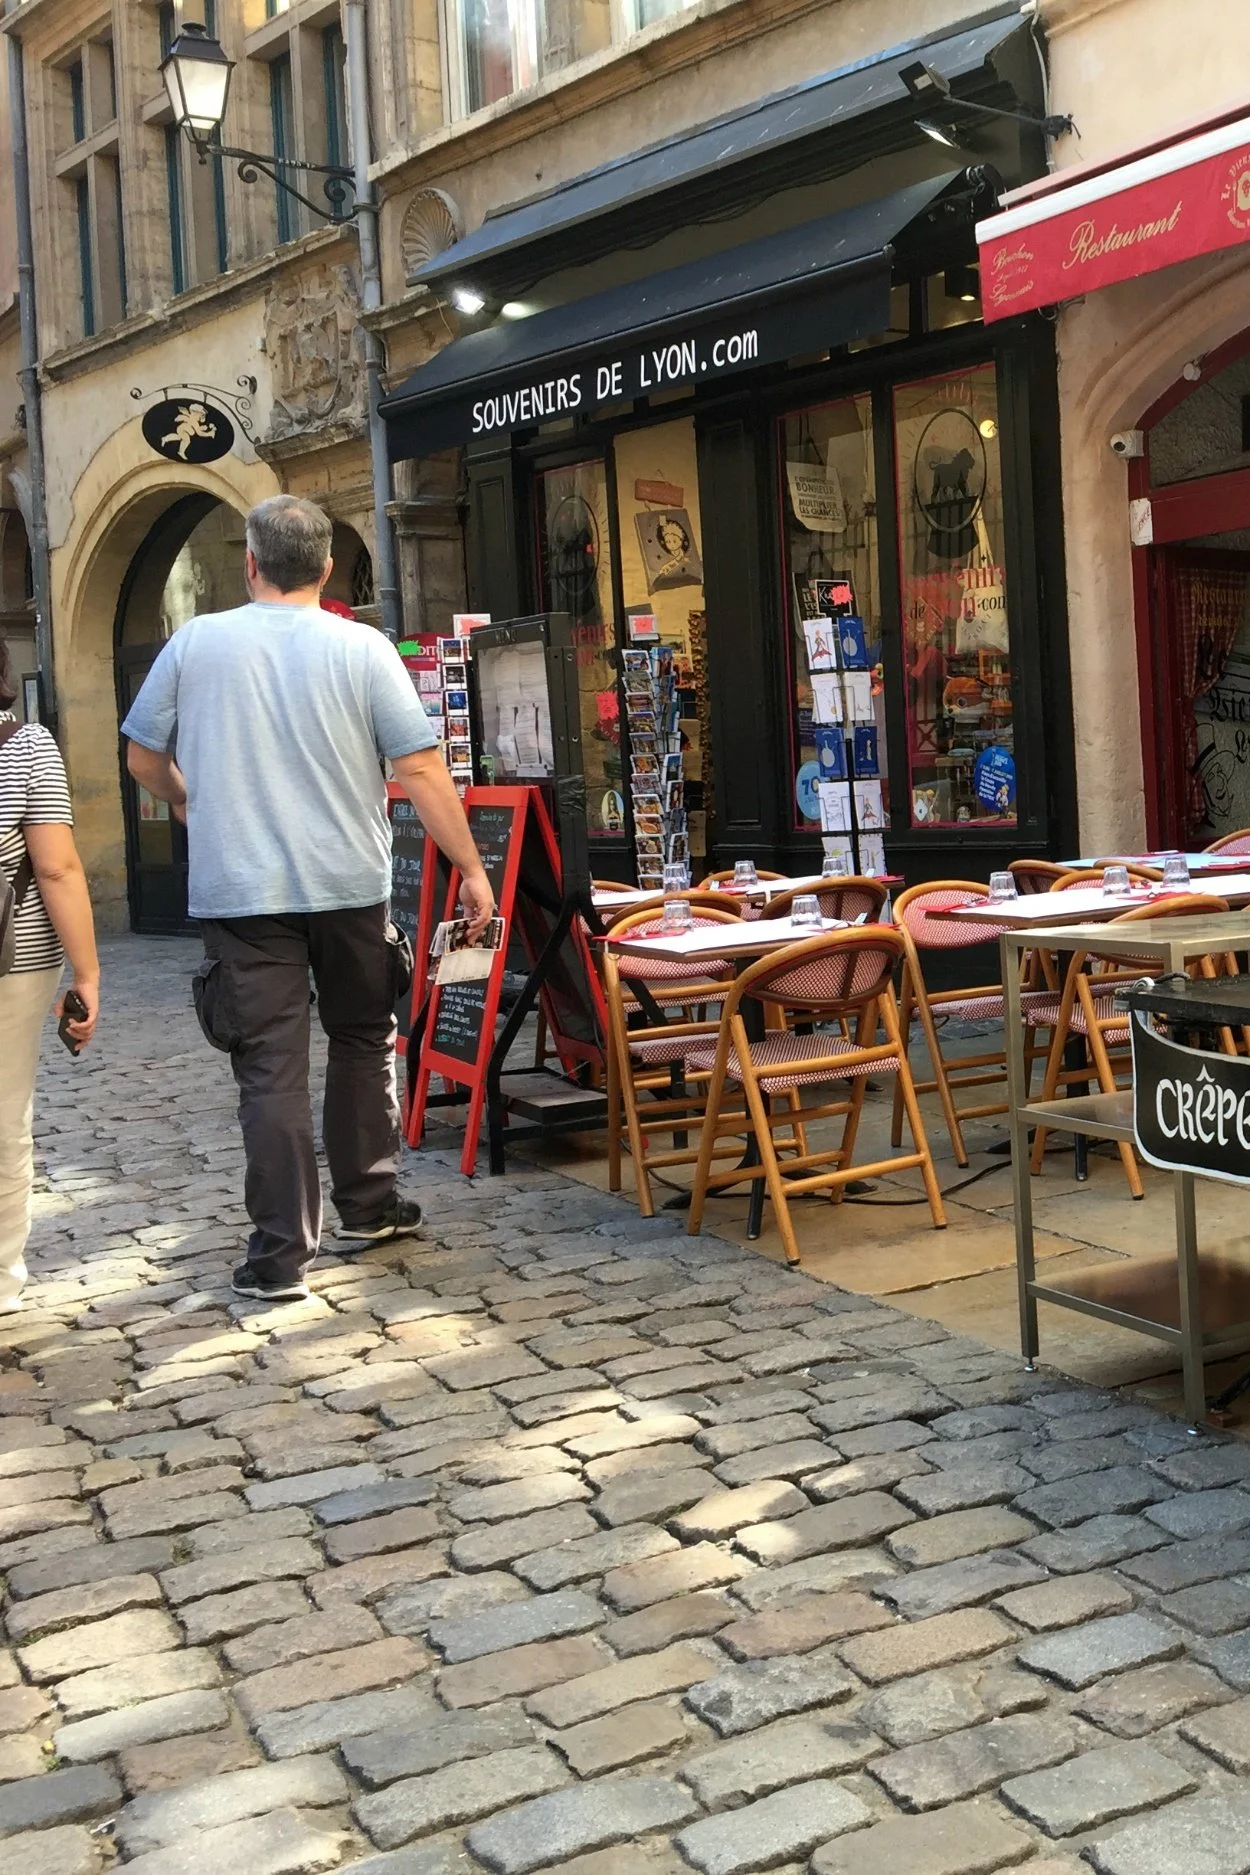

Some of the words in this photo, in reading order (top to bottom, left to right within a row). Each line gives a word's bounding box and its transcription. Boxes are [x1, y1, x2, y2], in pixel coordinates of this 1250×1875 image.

[1062, 200, 1182, 270] Restaurant
[471, 373, 582, 434] SOUVENIRS
[597, 361, 623, 400] DE
[640, 329, 759, 388] LYON.com
